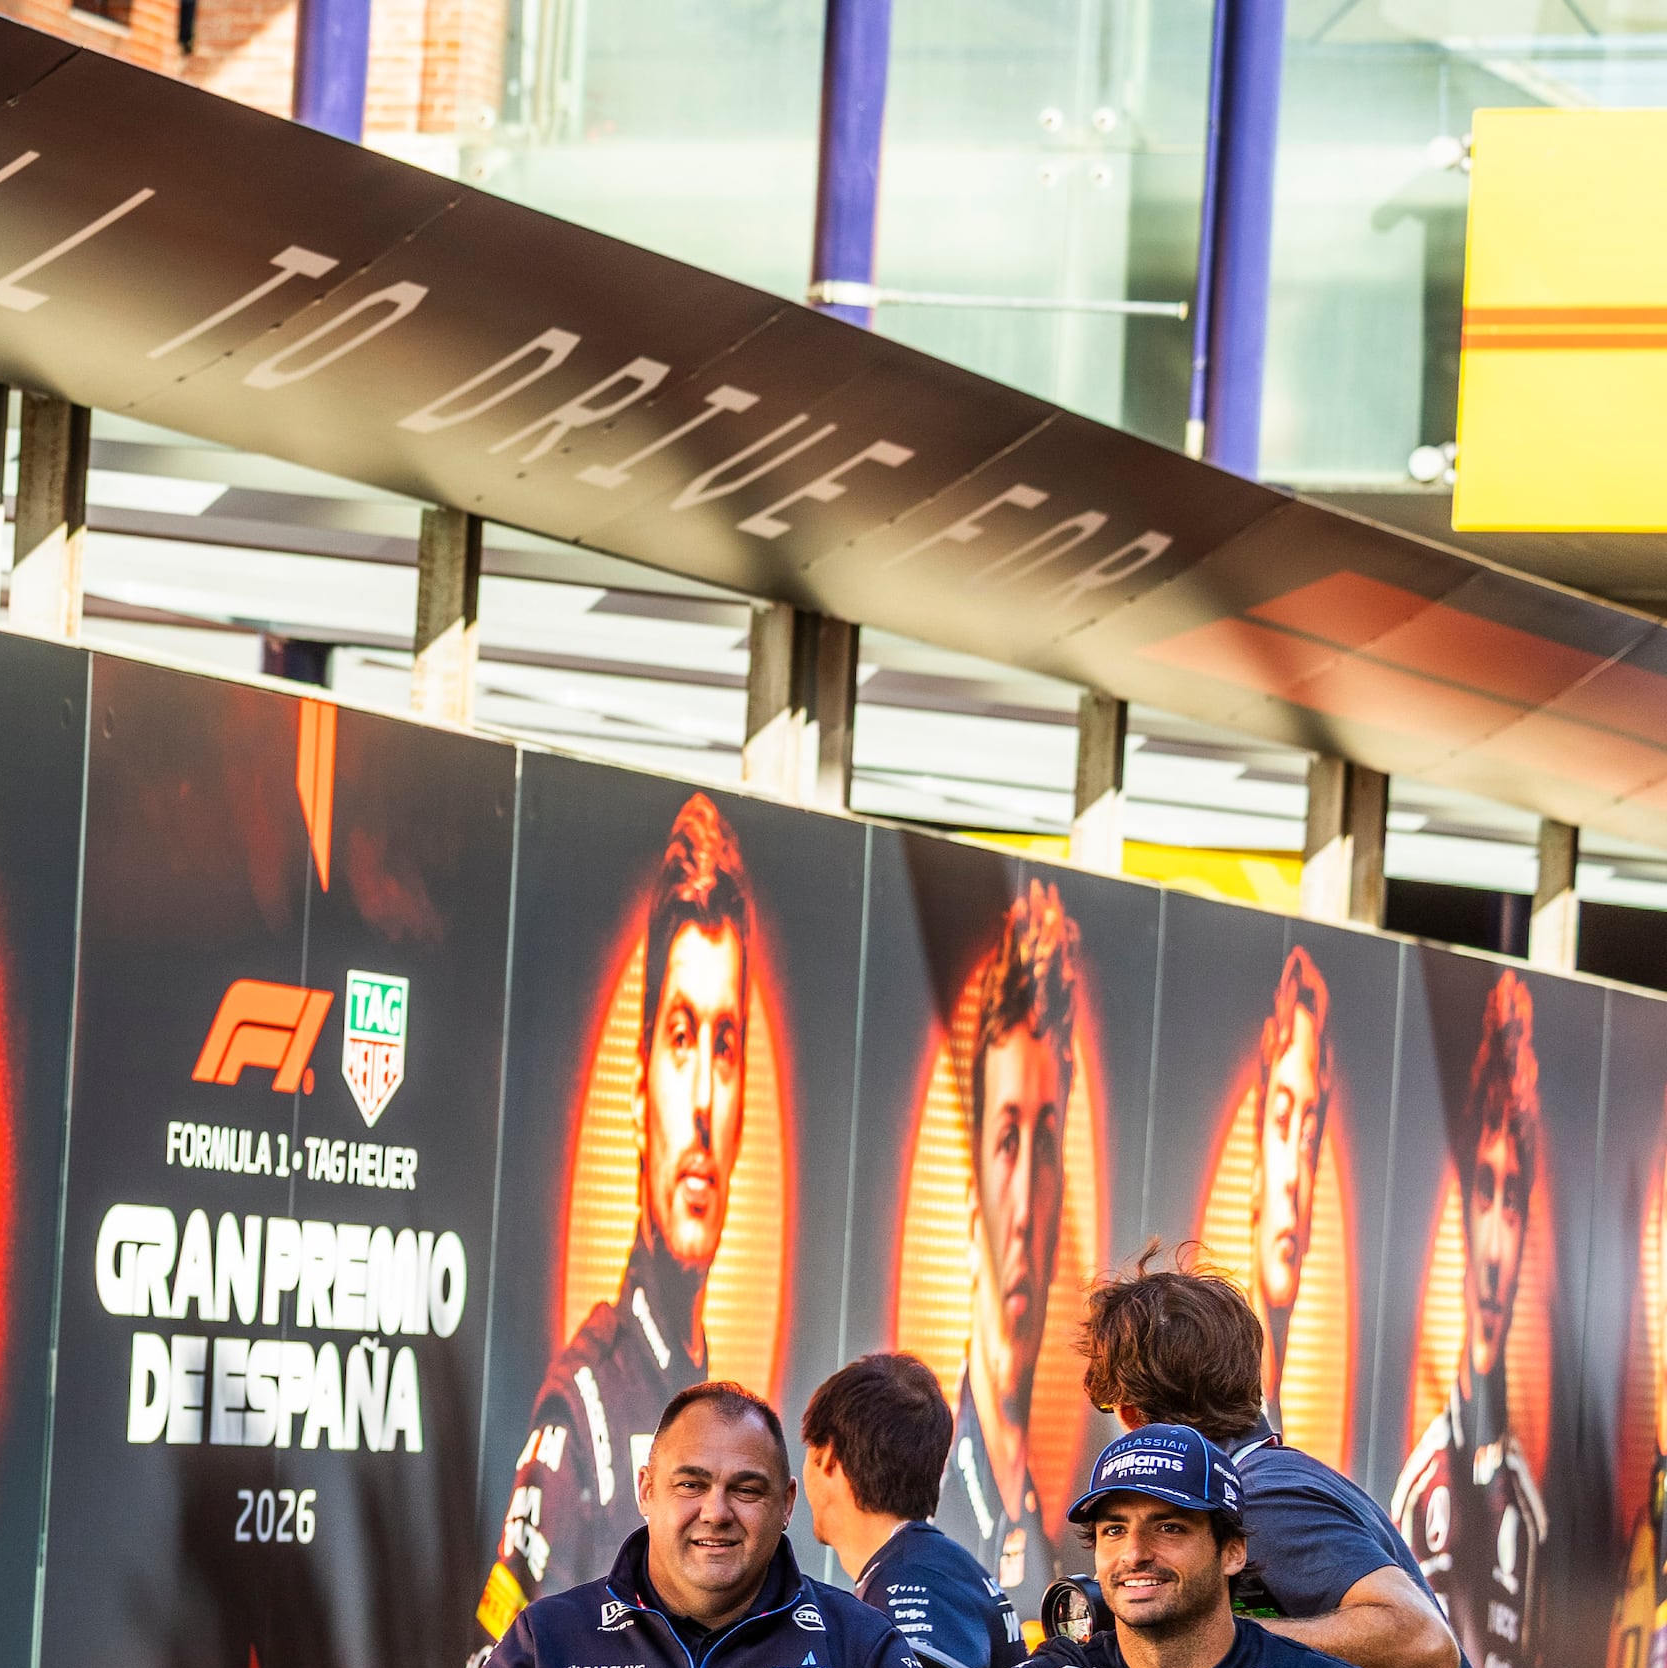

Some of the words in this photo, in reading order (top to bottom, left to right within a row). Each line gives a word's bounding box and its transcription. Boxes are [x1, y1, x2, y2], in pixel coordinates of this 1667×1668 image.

[147, 244, 428, 390] TO
[397, 326, 914, 539] DRIVE
[878, 483, 1173, 612] FOR
[352, 982, 402, 1035] TAG
[166, 1120, 273, 1176] FORMULA
[274, 1133, 290, 1178] 1
[304, 1136, 347, 1184] TAG
[347, 1142, 418, 1191] HEUER
[95, 1203, 262, 1326] GRAN
[262, 1216, 468, 1340] PREMIO
[126, 1331, 208, 1446] DE
[209, 1336, 424, 1453] ESPAÑA
[1100, 1453, 1185, 1481] Williams
[1113, 1437, 1189, 1455] ATLASSIAN
[1117, 1468, 1128, 1479] F1
[1129, 1466, 1158, 1476] TEAM
[234, 1488, 317, 1544] 2026
[795, 1611, 823, 1625] Gul
